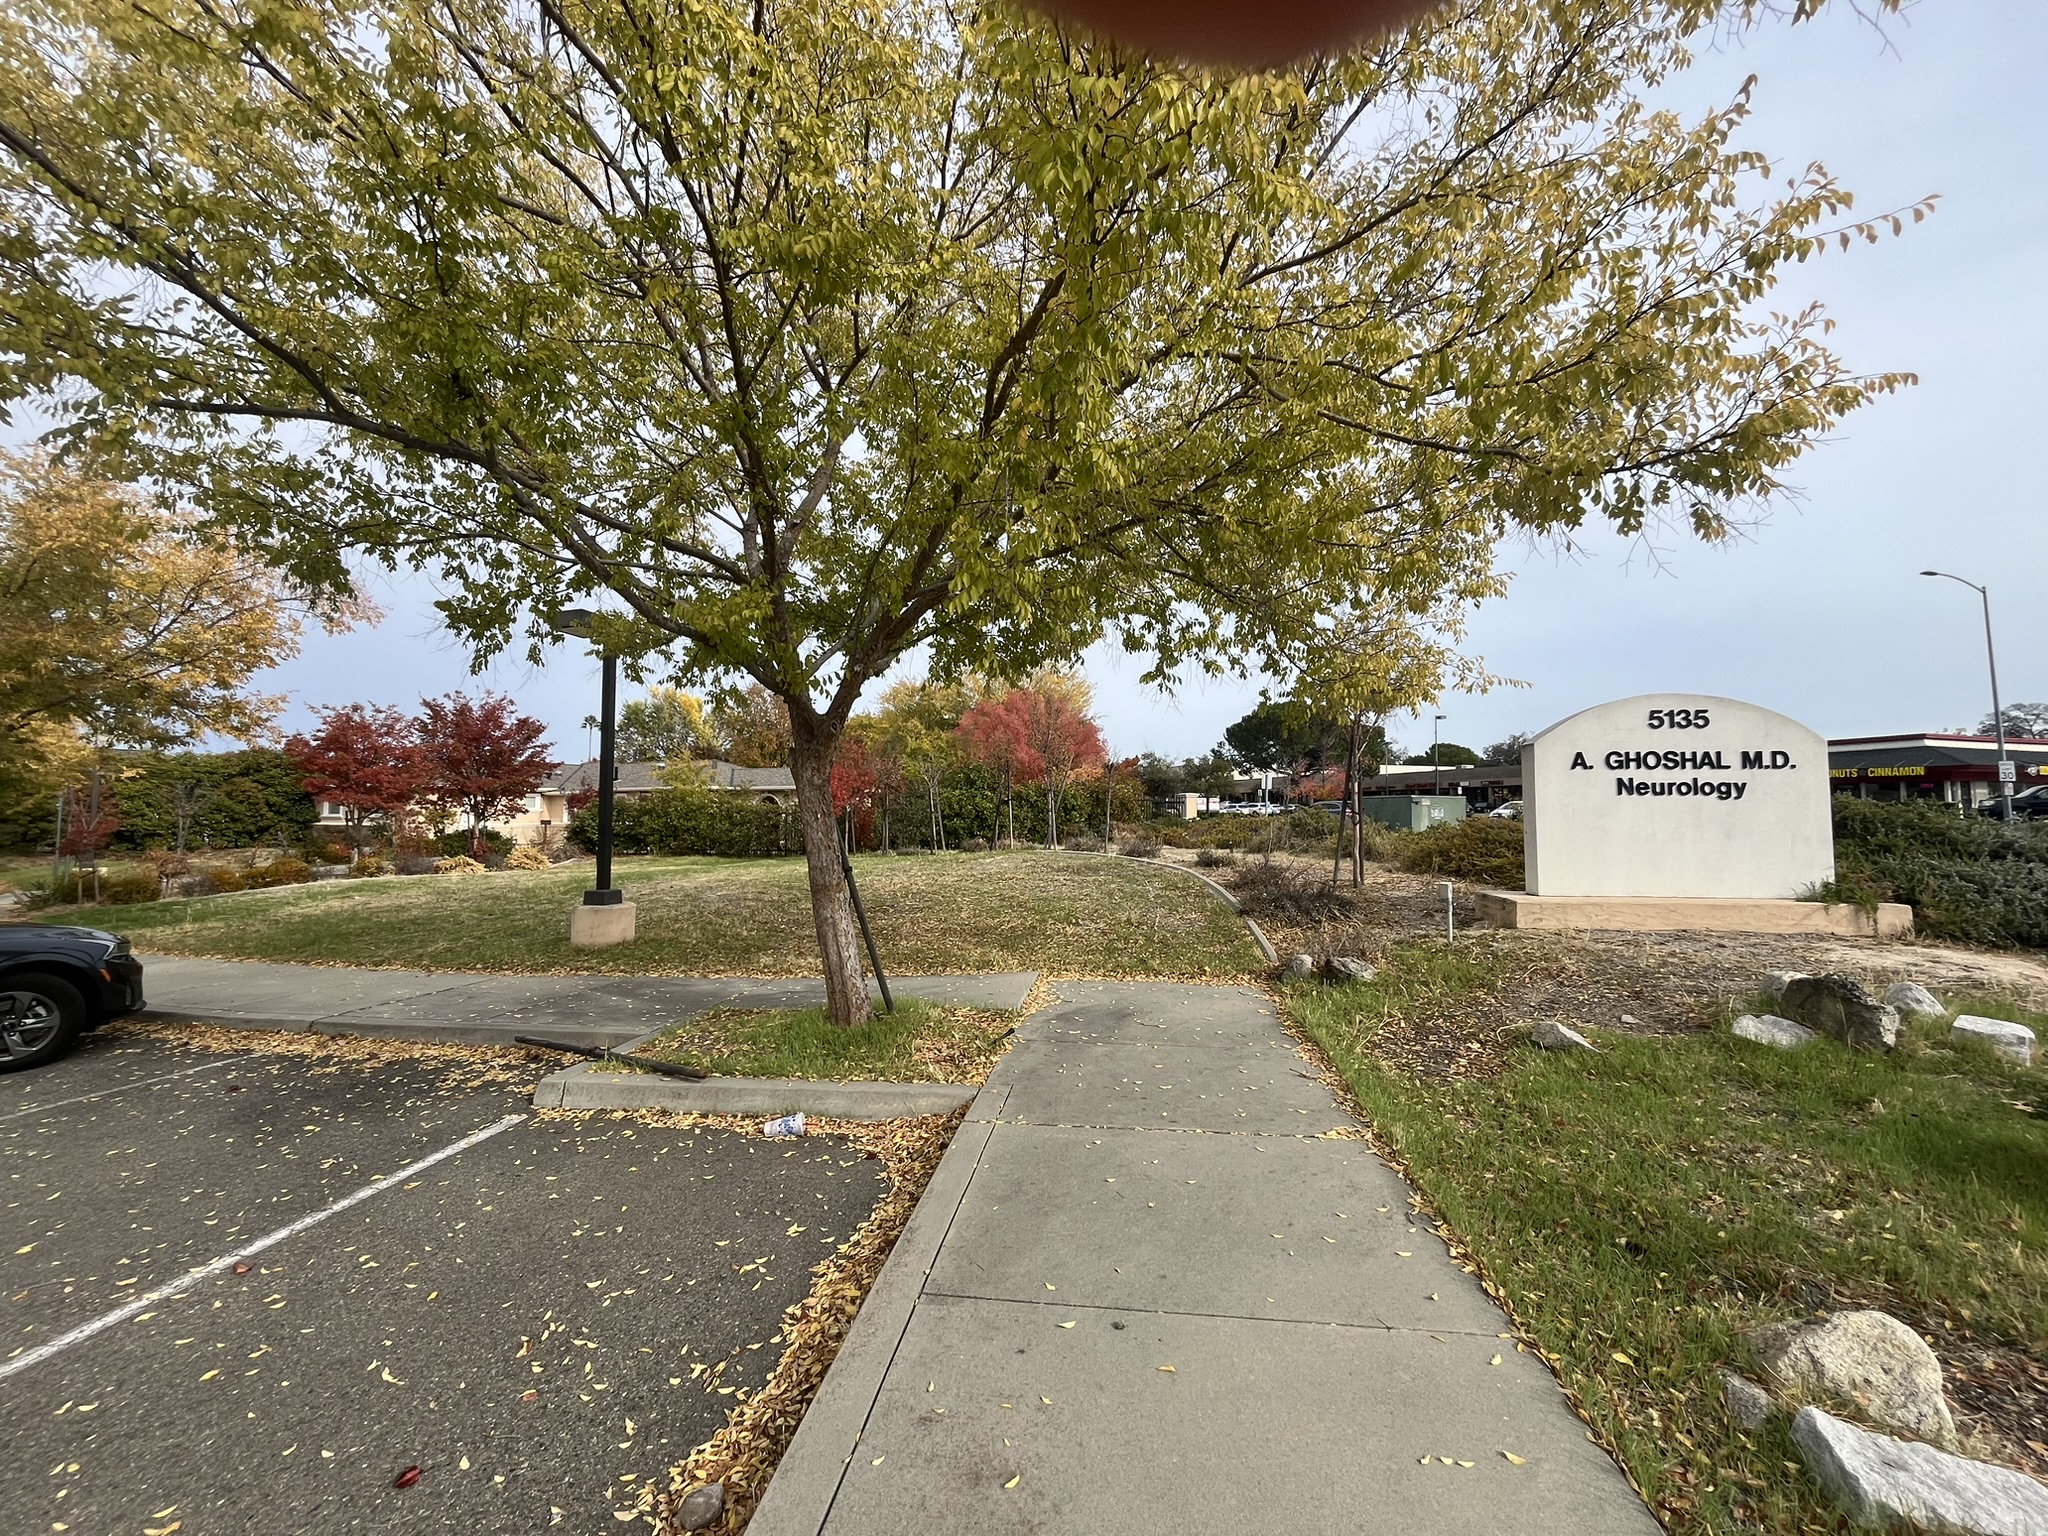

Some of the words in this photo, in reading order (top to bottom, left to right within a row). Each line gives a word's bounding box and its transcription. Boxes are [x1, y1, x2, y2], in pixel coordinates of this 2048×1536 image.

[1648, 709, 1710, 730] 5135
[1570, 751, 1594, 770] A.
[1605, 751, 1731, 770] GHOSHAL
[1741, 751, 1797, 770] M.D.
[1867, 766, 1925, 777] CINNAMON
[2001, 771, 2014, 780] 30
[1617, 778, 1748, 801] Neurology
